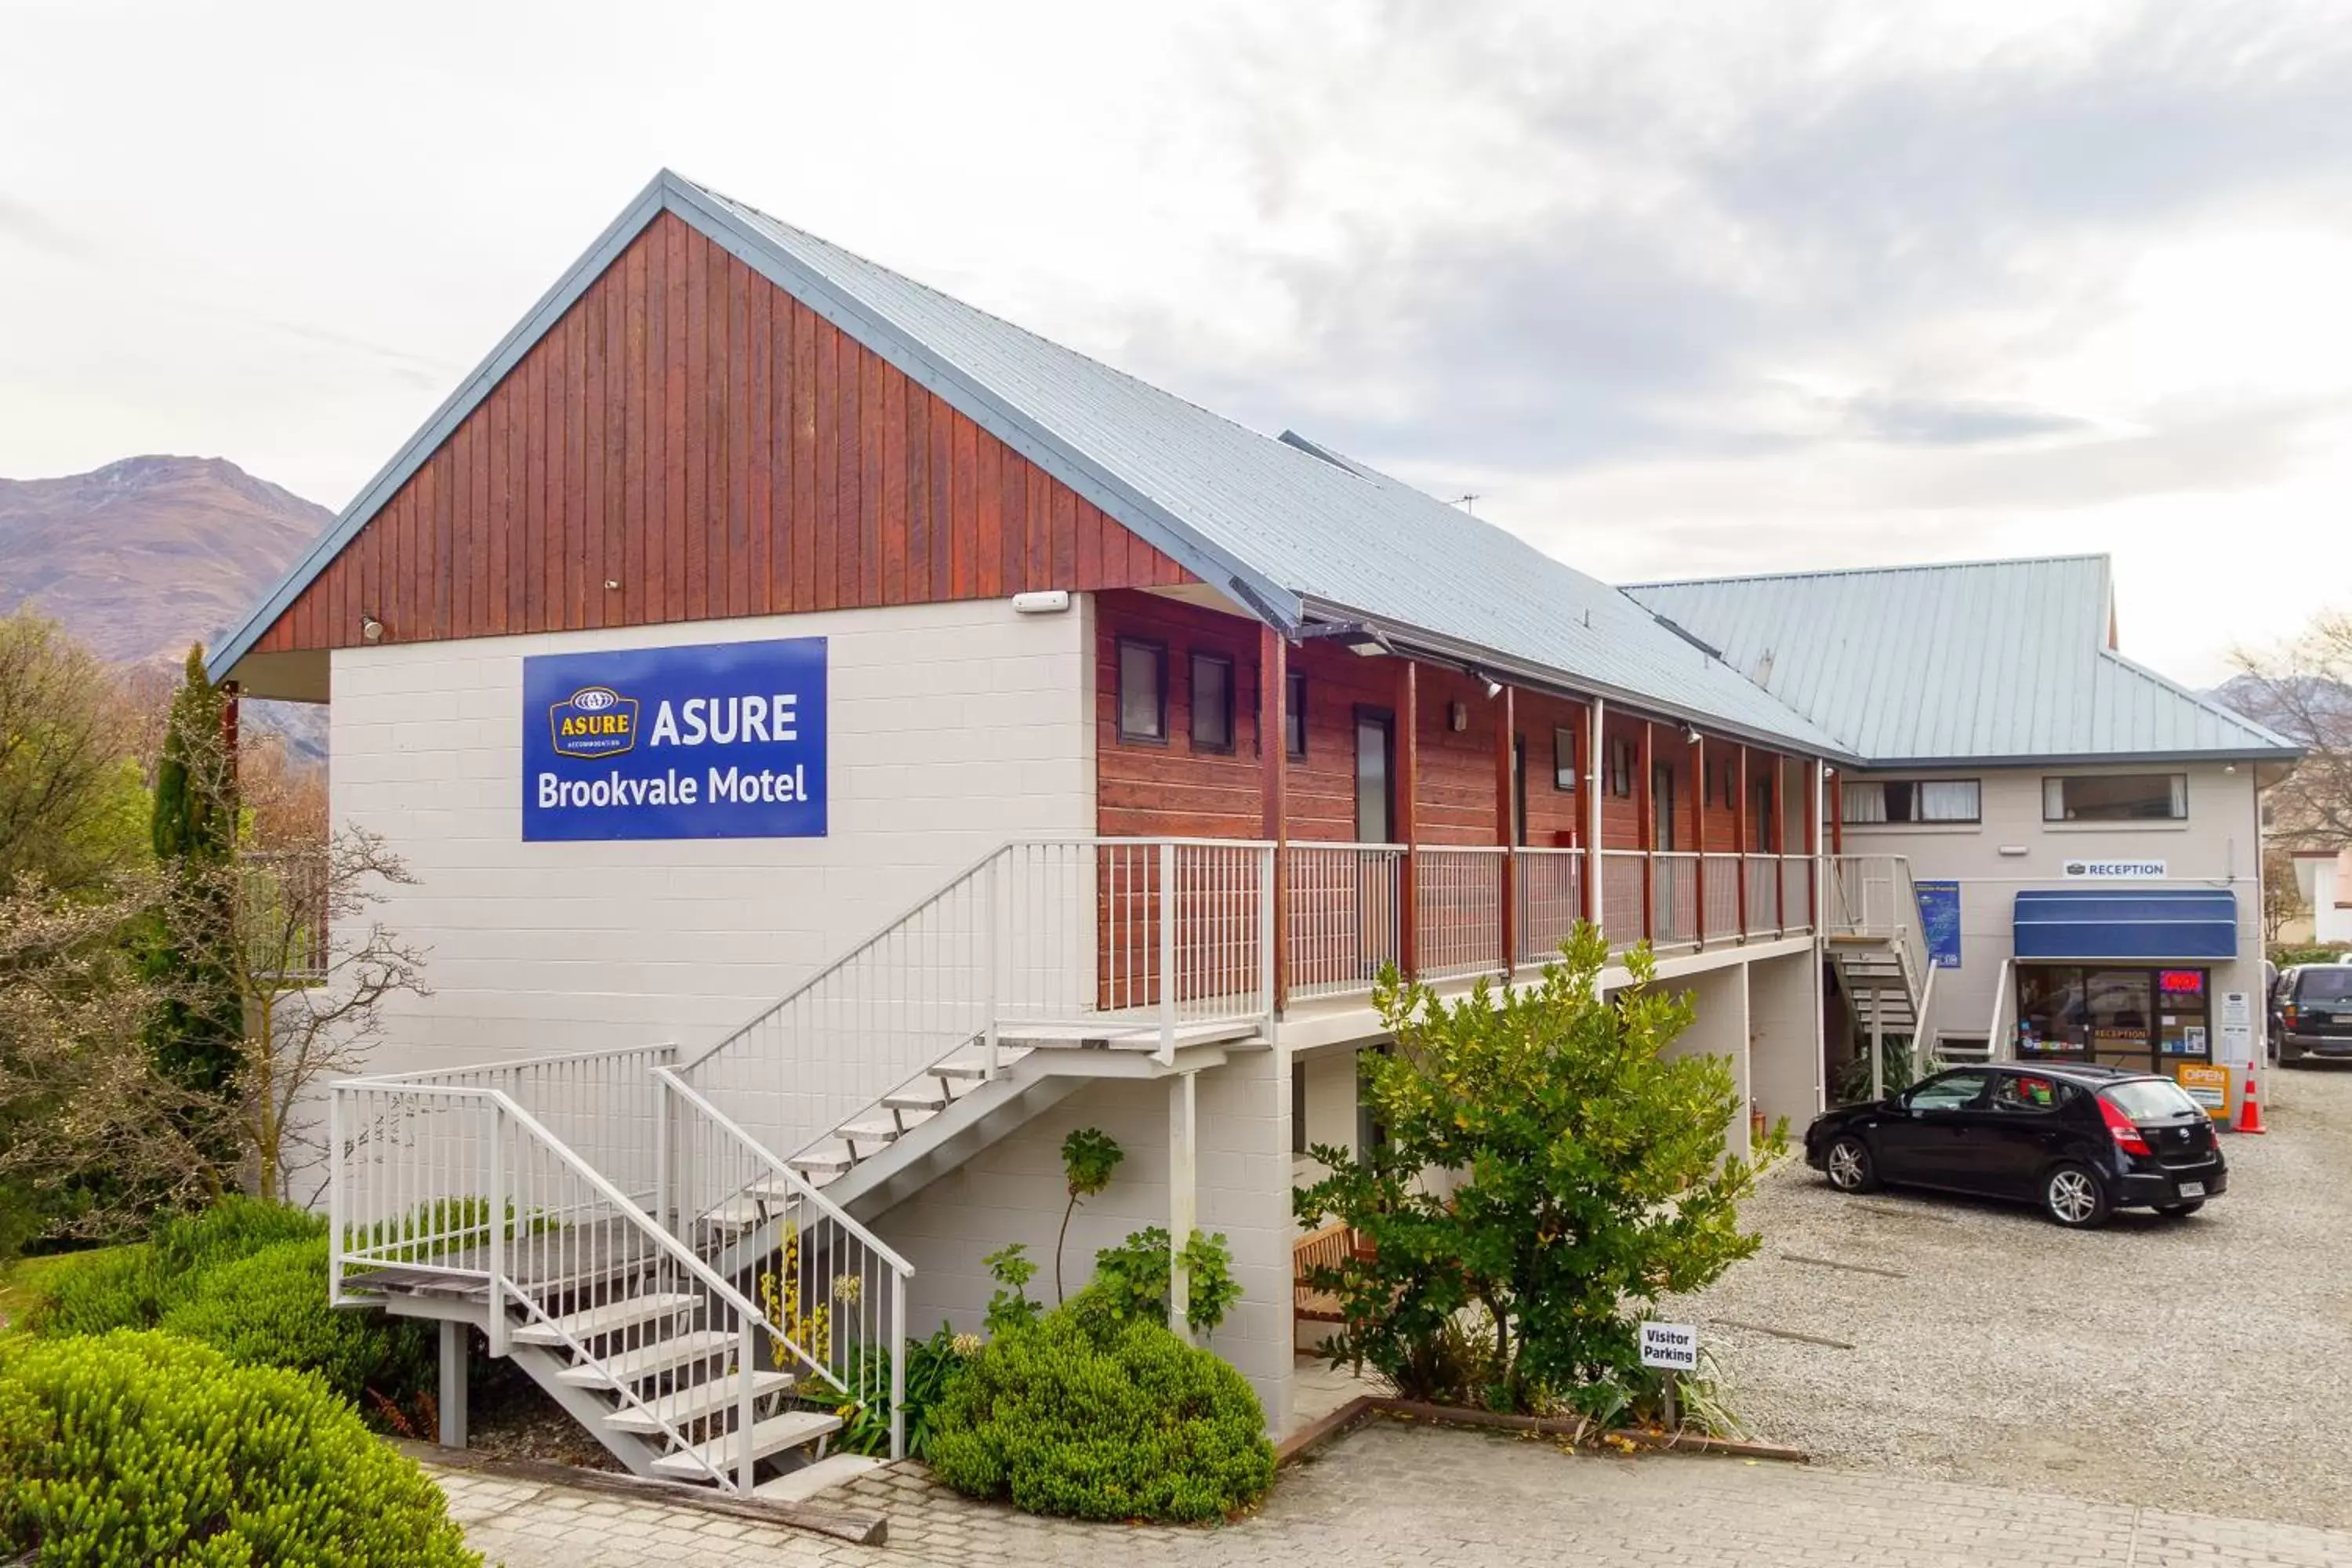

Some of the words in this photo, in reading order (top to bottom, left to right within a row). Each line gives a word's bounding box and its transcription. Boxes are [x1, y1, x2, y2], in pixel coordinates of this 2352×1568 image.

[561, 714, 629, 735] ASURE
[650, 694, 797, 747] ASURE
[538, 768, 697, 808] Brookvale
[709, 764, 808, 804] Motel
[2089, 865, 2164, 875] RECEPTION
[2184, 1069, 2225, 1083] OPEN
[1646, 1330, 1690, 1345] Visitor
[1644, 1345, 1693, 1363] Parking
